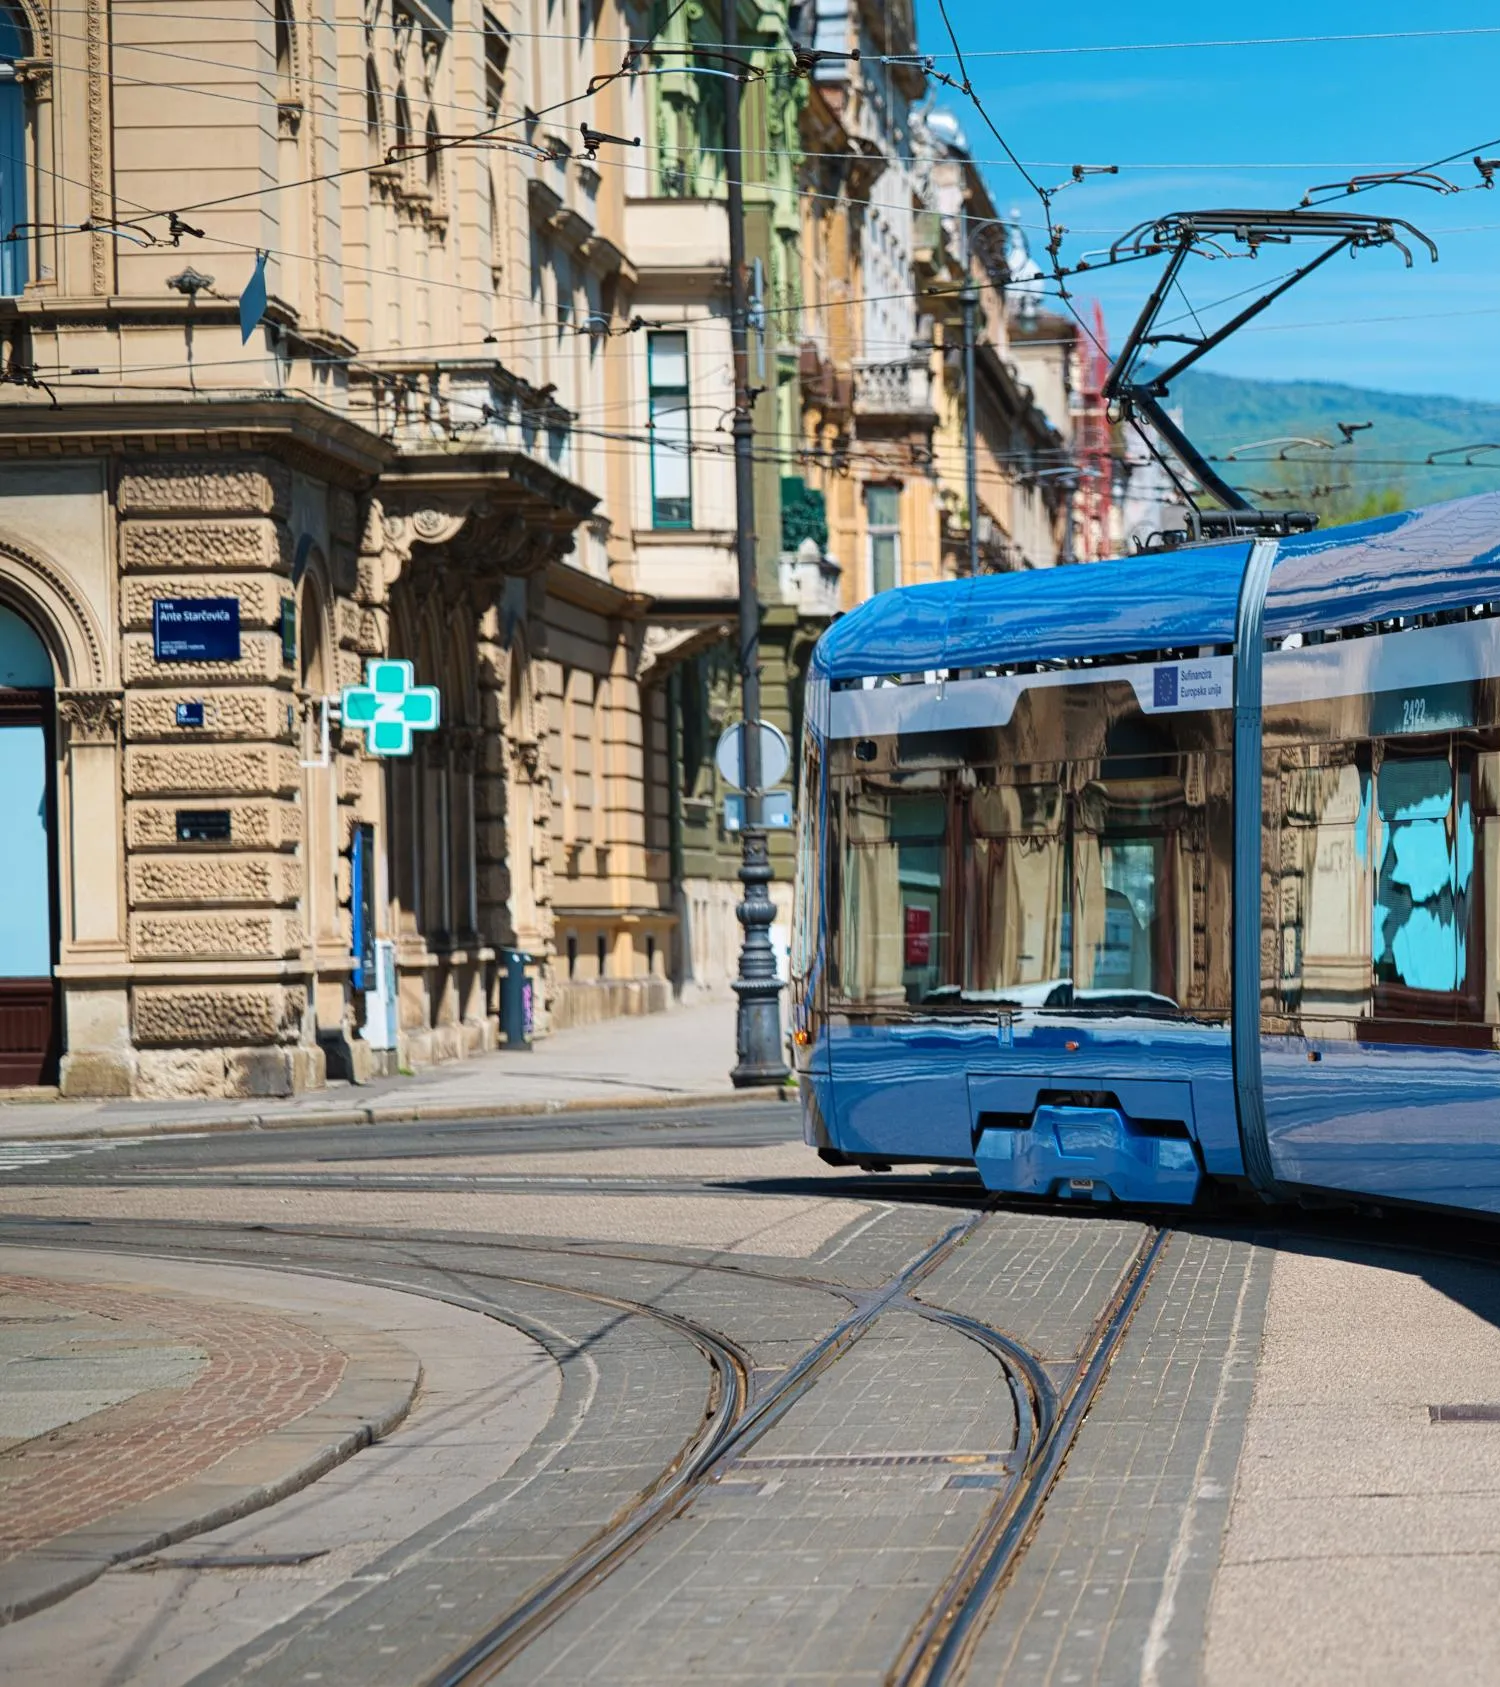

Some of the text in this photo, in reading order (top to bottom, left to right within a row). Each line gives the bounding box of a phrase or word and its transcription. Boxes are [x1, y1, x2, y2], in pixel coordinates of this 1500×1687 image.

[160, 609, 230, 622] Ante Starčevića
[1180, 683, 1222, 699] Europska unija
[1403, 698, 1426, 726] 2422
